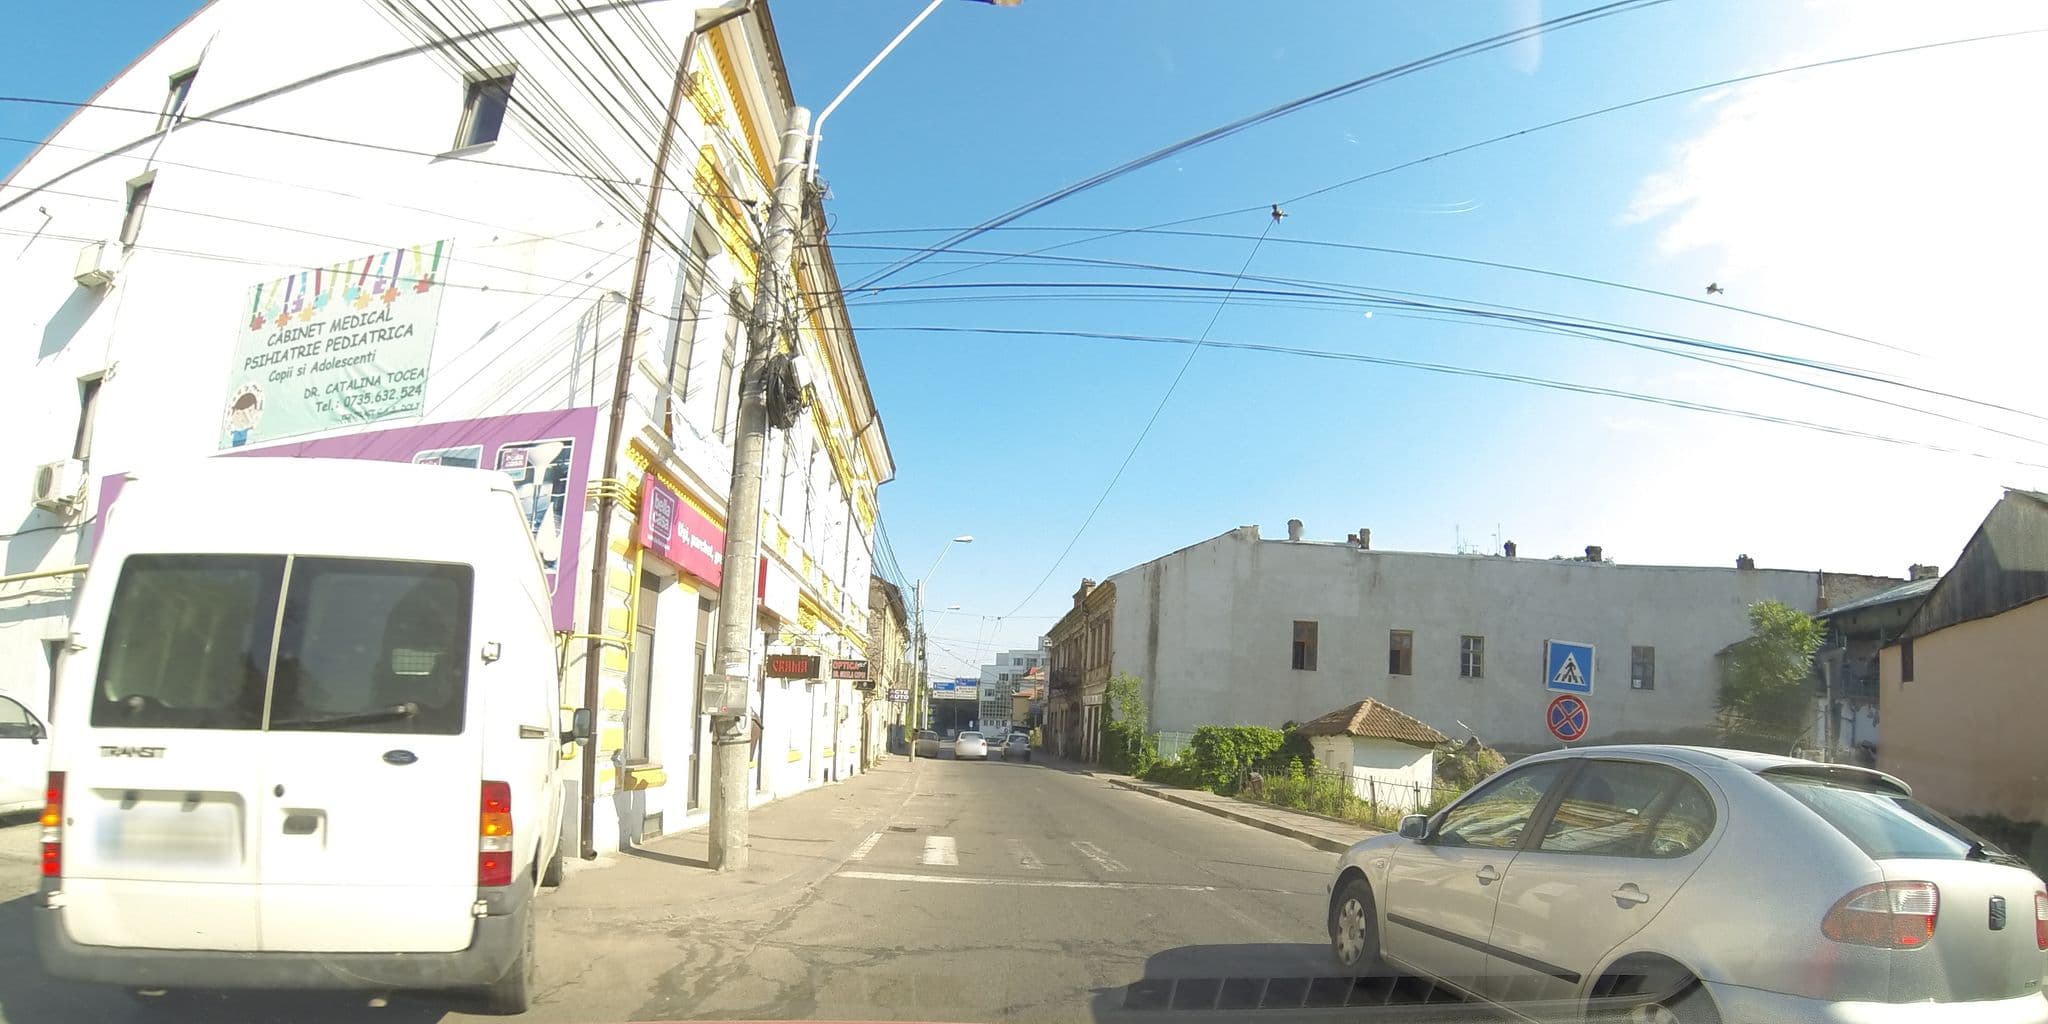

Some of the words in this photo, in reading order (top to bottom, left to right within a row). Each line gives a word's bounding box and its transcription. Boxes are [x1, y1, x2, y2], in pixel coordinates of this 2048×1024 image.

[267, 321, 325, 347] CABINET
[329, 307, 394, 333] MEDICAL
[244, 341, 321, 371] PSIHIATRIE
[325, 323, 414, 353] PEDIATRICA
[268, 364, 293, 384] Copii
[297, 363, 307, 377] si
[310, 349, 377, 375] Adolescenti
[304, 385, 320, 399] DR.
[325, 376, 381, 395] CATALINA
[386, 367, 425, 384] TOCEA
[343, 385, 422, 409] 0735.632.524
[832, 661, 860, 670] OPTICA
[100, 745, 167, 758] TRANSIT
